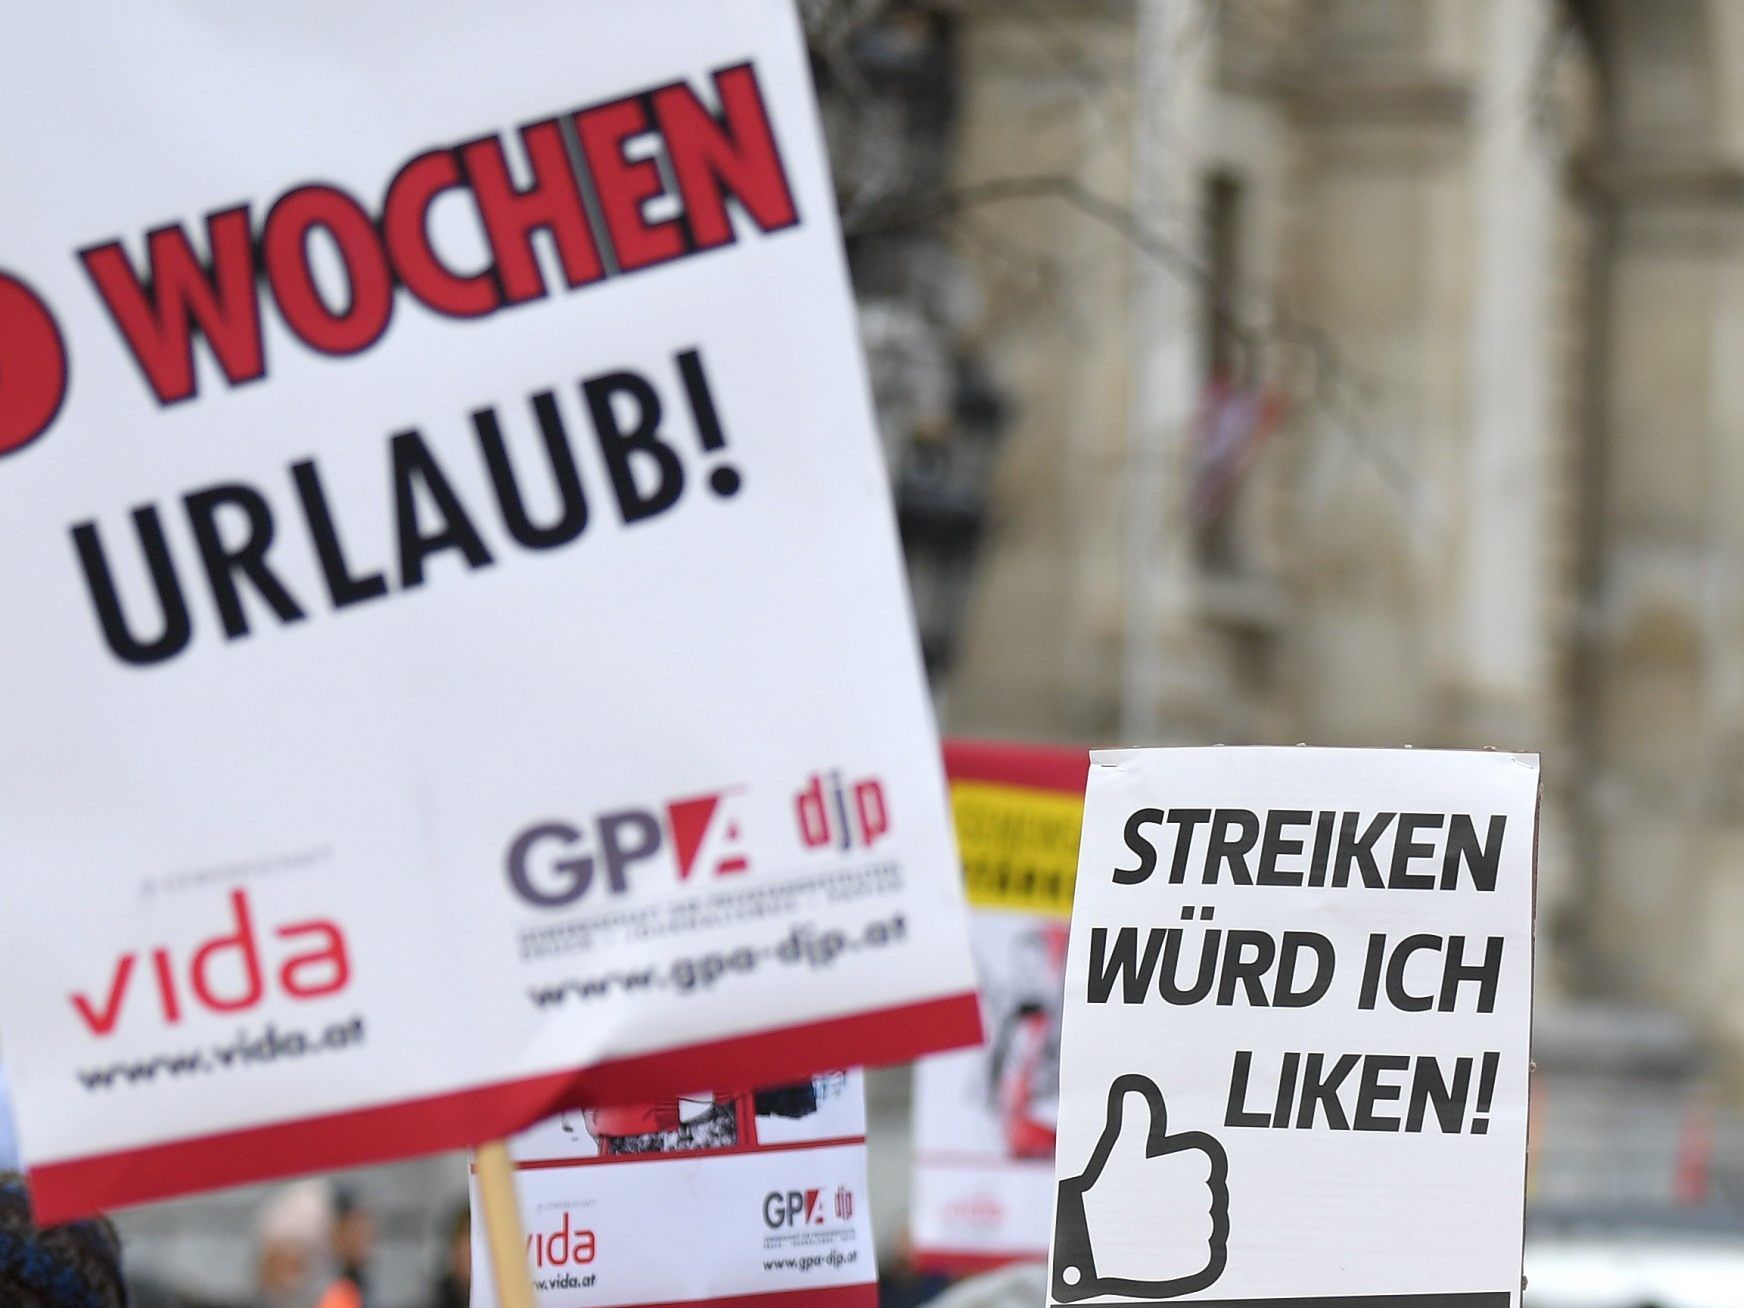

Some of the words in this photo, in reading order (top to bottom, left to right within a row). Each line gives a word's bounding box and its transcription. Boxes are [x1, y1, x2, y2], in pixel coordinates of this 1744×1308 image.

[76, 60, 801, 407] WOCHEN
[71, 347, 741, 667] URLAUB!
[1112, 808, 1507, 892] STREIKEN
[70, 887, 353, 1037] vida
[526, 912, 908, 1008] www.gpa-djp.at
[1087, 905, 1336, 1008] WÜRD
[1358, 933, 1504, 1013] ICH
[78, 1014, 366, 1090] www.vida.at
[1224, 1051, 1500, 1134] LIKEN!
[763, 1249, 858, 1272] www.gpa-djp.at
